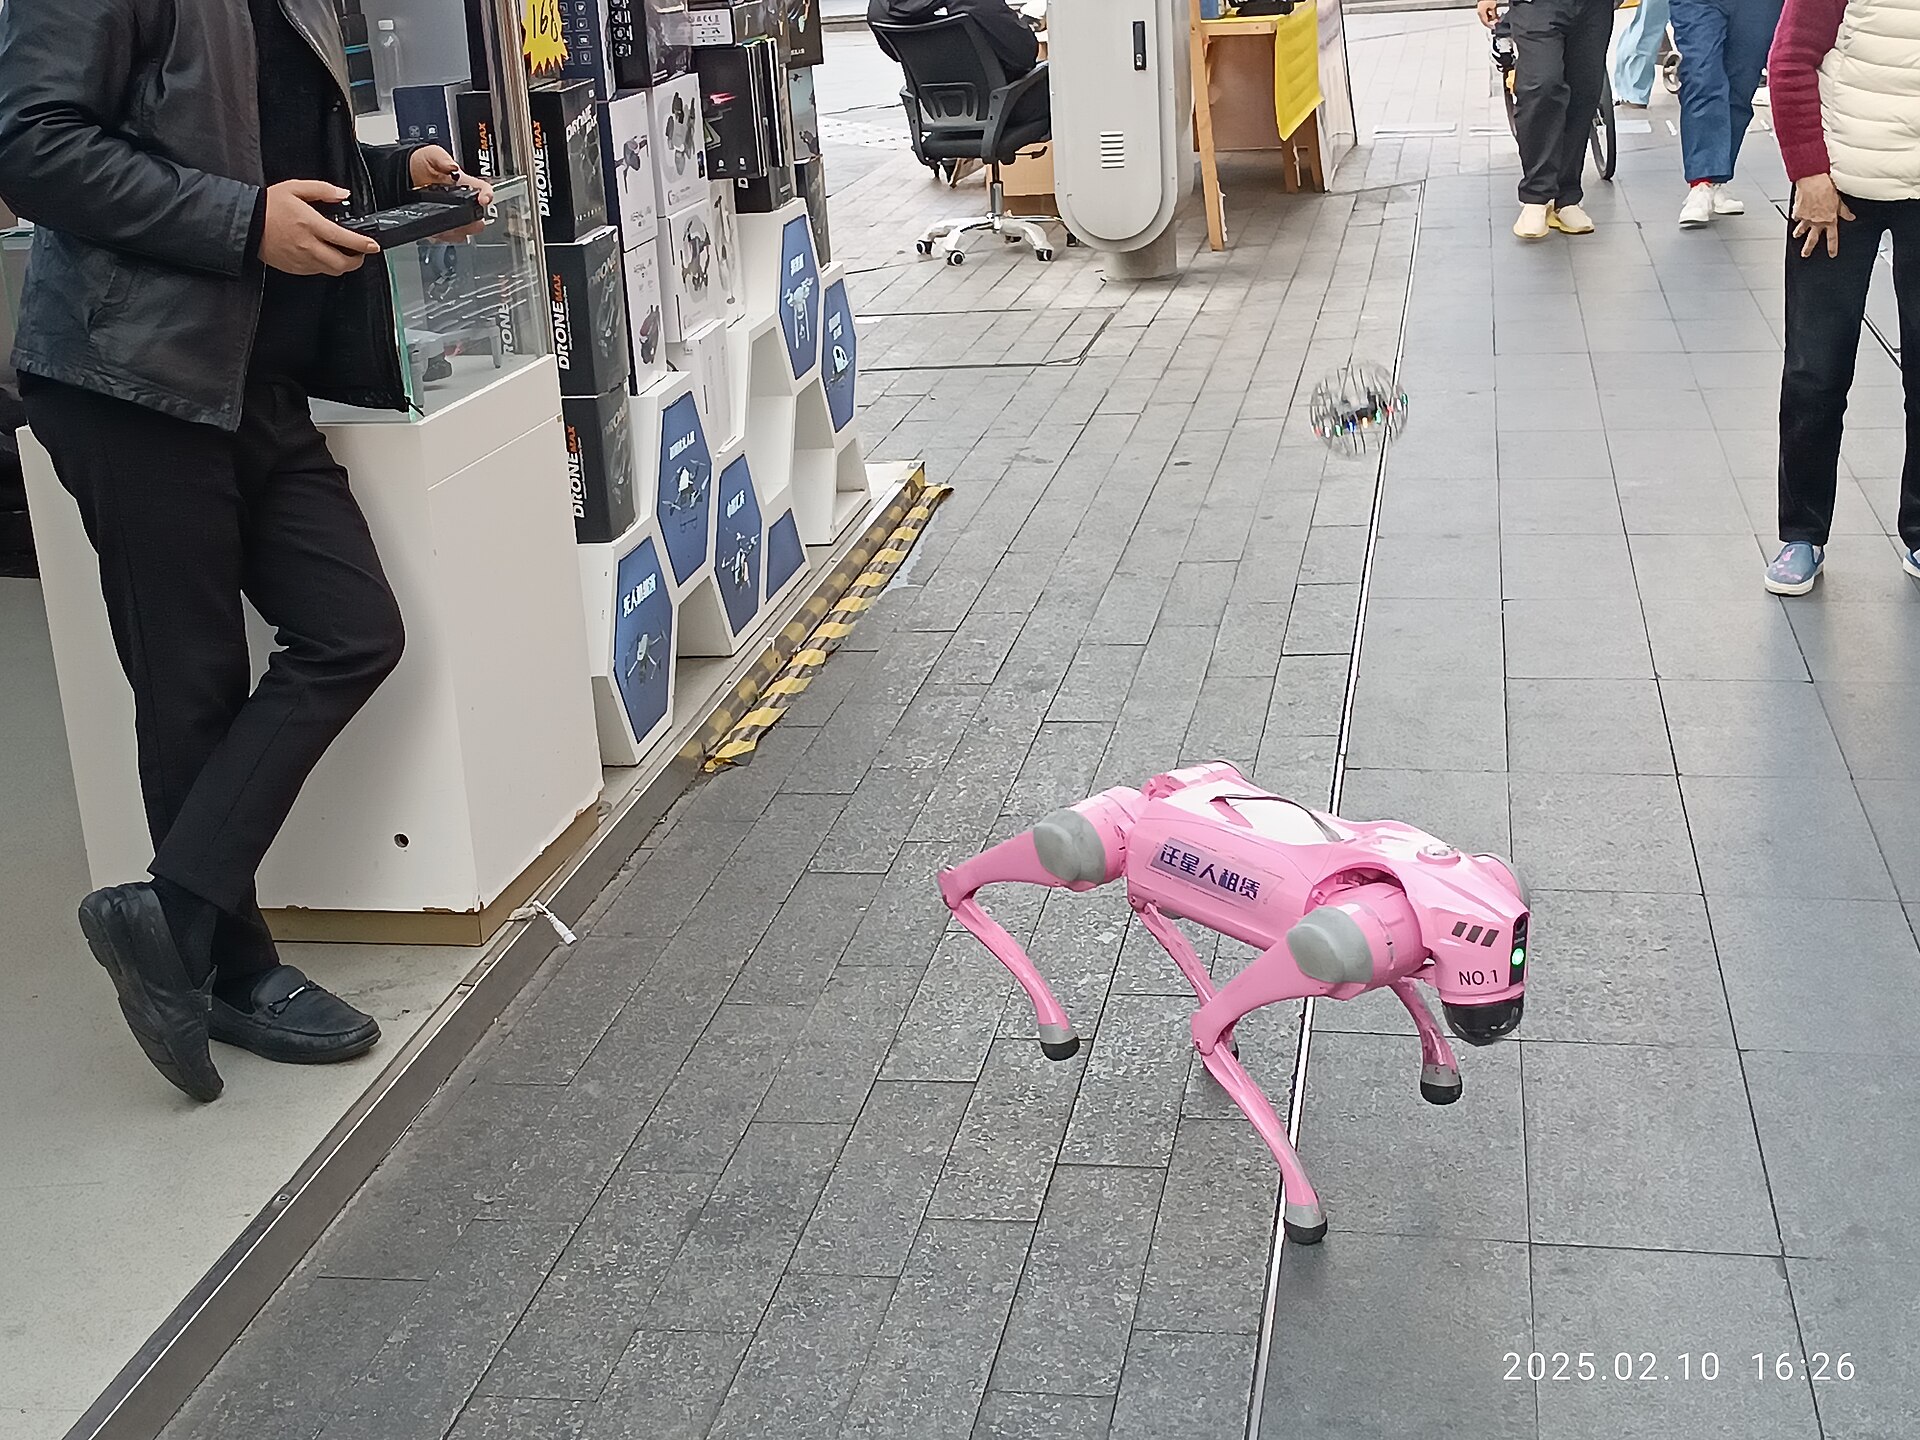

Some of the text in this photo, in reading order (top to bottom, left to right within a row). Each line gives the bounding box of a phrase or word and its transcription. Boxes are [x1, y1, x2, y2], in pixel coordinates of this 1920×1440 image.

[1160, 844, 1260, 900] 汪星人租赁
[1459, 969, 1497, 986] NO.1
